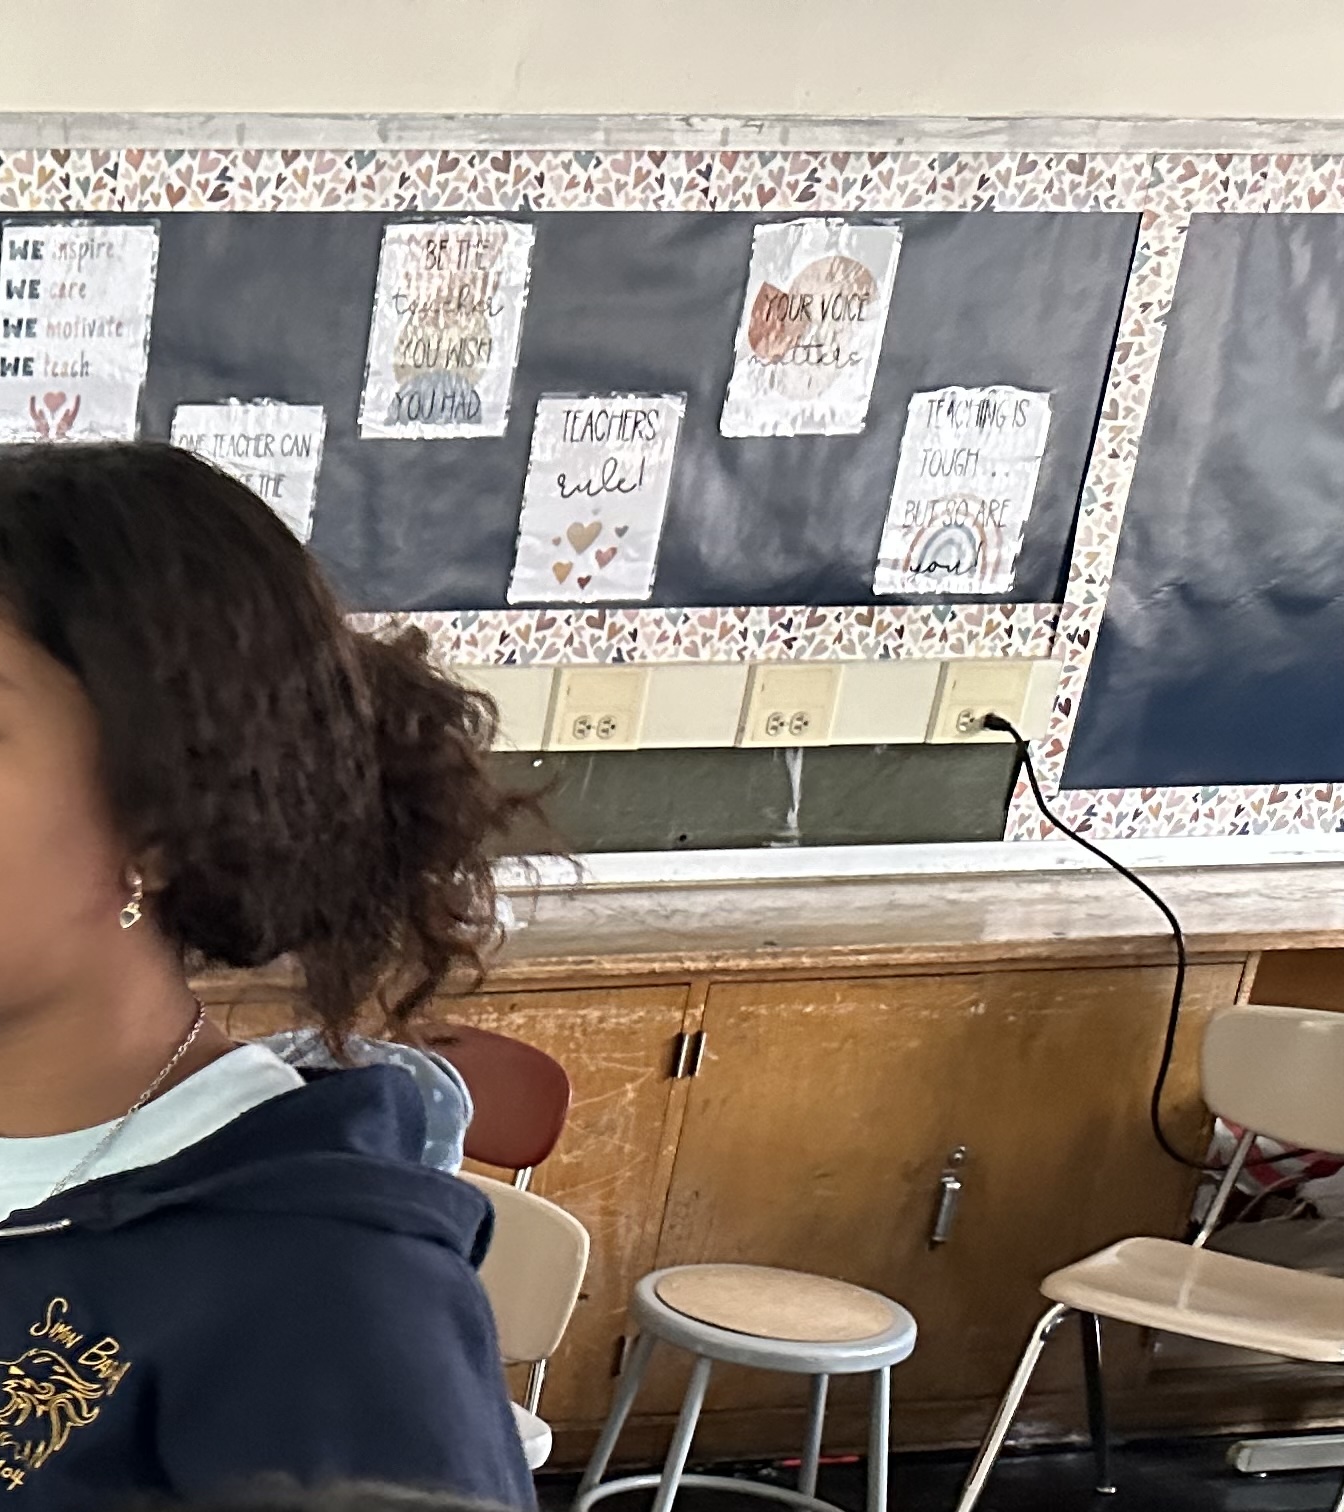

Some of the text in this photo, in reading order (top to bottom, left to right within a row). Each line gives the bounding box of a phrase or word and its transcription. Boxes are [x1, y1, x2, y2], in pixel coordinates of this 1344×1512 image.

[9, 238, 115, 273] WE inspire
[425, 239, 449, 270] BE
[6, 279, 87, 299] WE care
[765, 292, 871, 322] YOUR VOICE
[2, 316, 123, 339] WE motivate
[0, 351, 90, 377] WE teach
[445, 336, 492, 368] WISH
[395, 388, 481, 420] YOU HAD
[927, 397, 1030, 429] TEACHING IS
[562, 409, 659, 443] TEACHERS
[214, 433, 275, 458] TEACHER
[280, 433, 312, 457] CAN
[258, 473, 286, 498] THE
[557, 456, 646, 499] rule!
[903, 499, 1012, 528] BUT SO ARE
